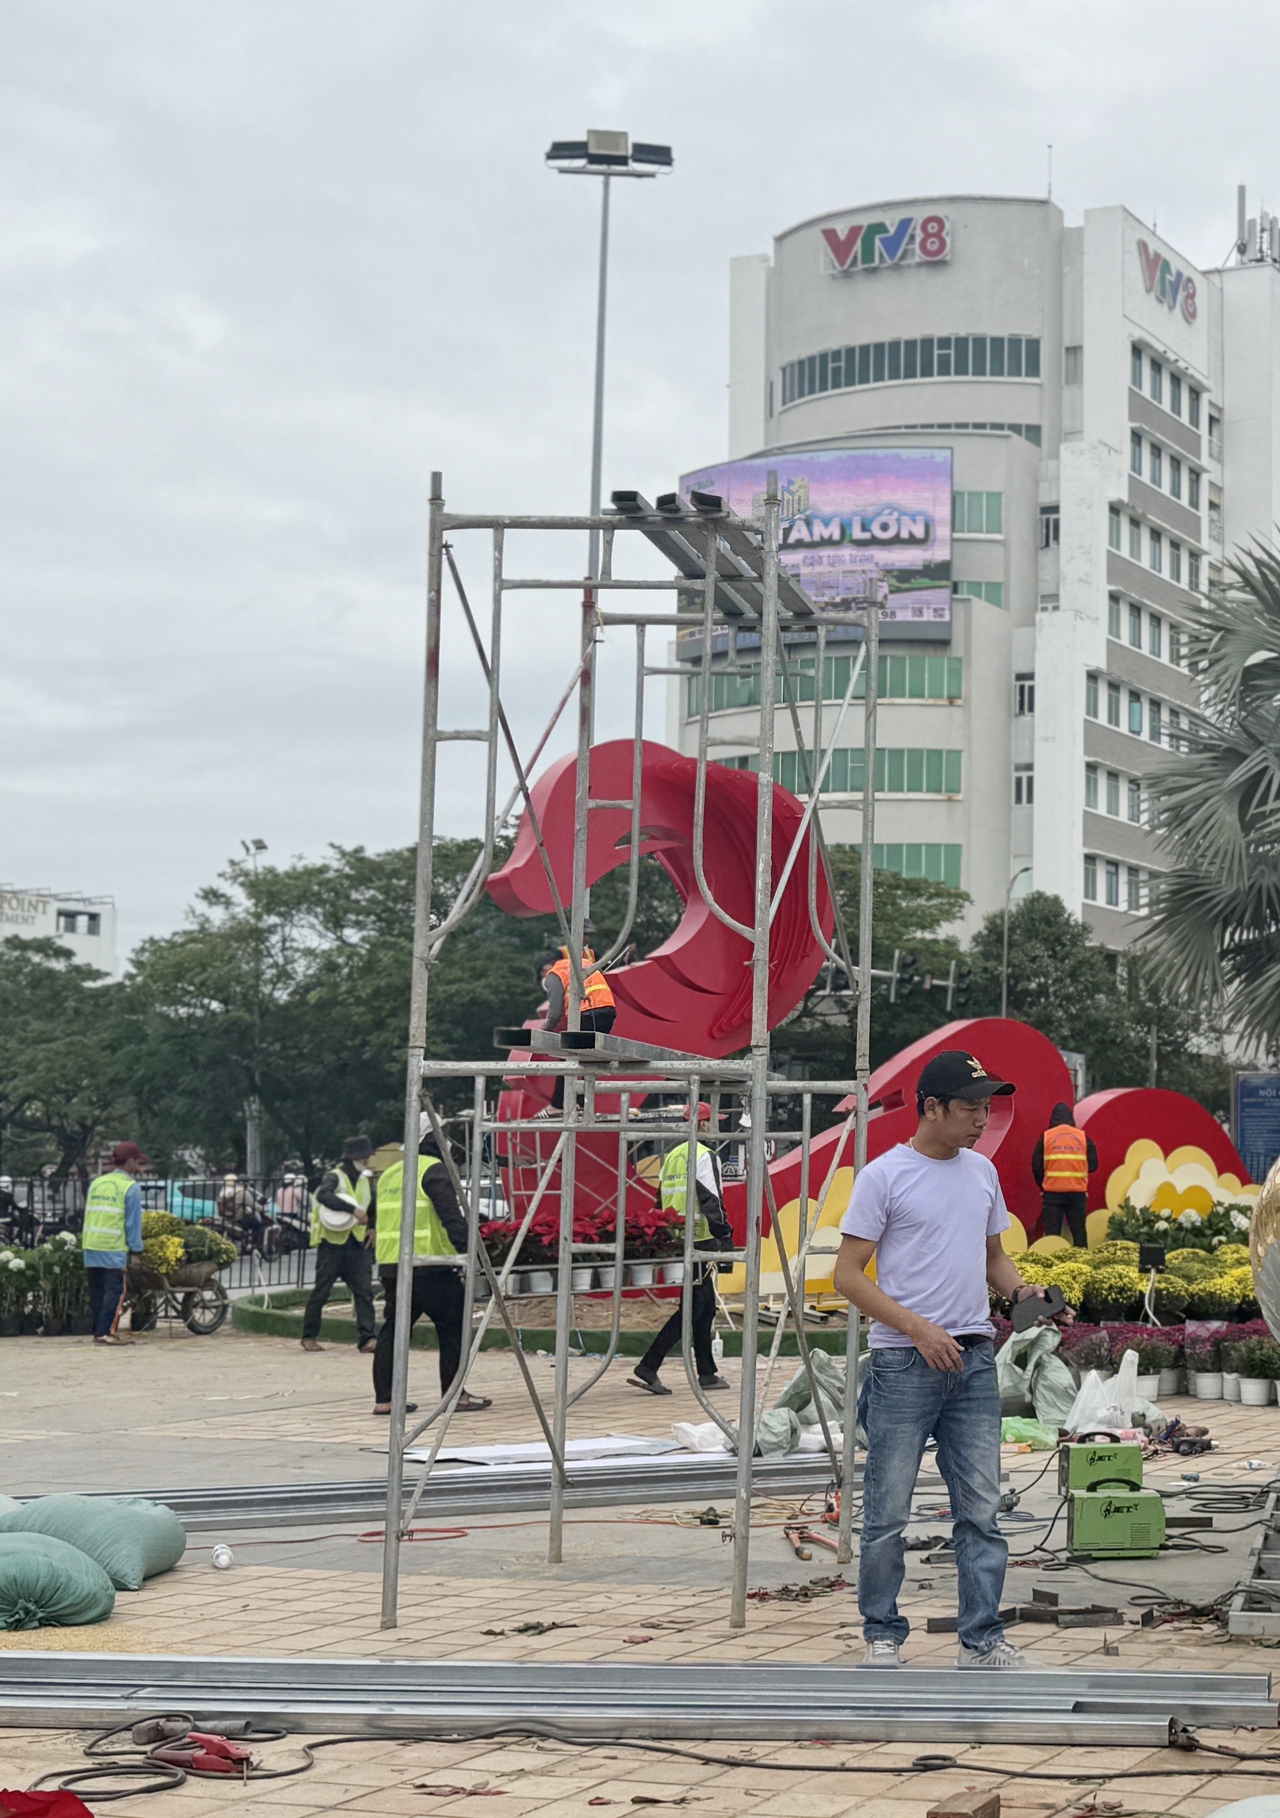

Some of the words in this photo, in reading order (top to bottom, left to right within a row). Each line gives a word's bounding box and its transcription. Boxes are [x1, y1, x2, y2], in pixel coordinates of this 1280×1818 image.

[820, 214, 949, 269] VTV8
[1136, 237, 1198, 324] VTV8
[851, 509, 926, 541] LỚN
